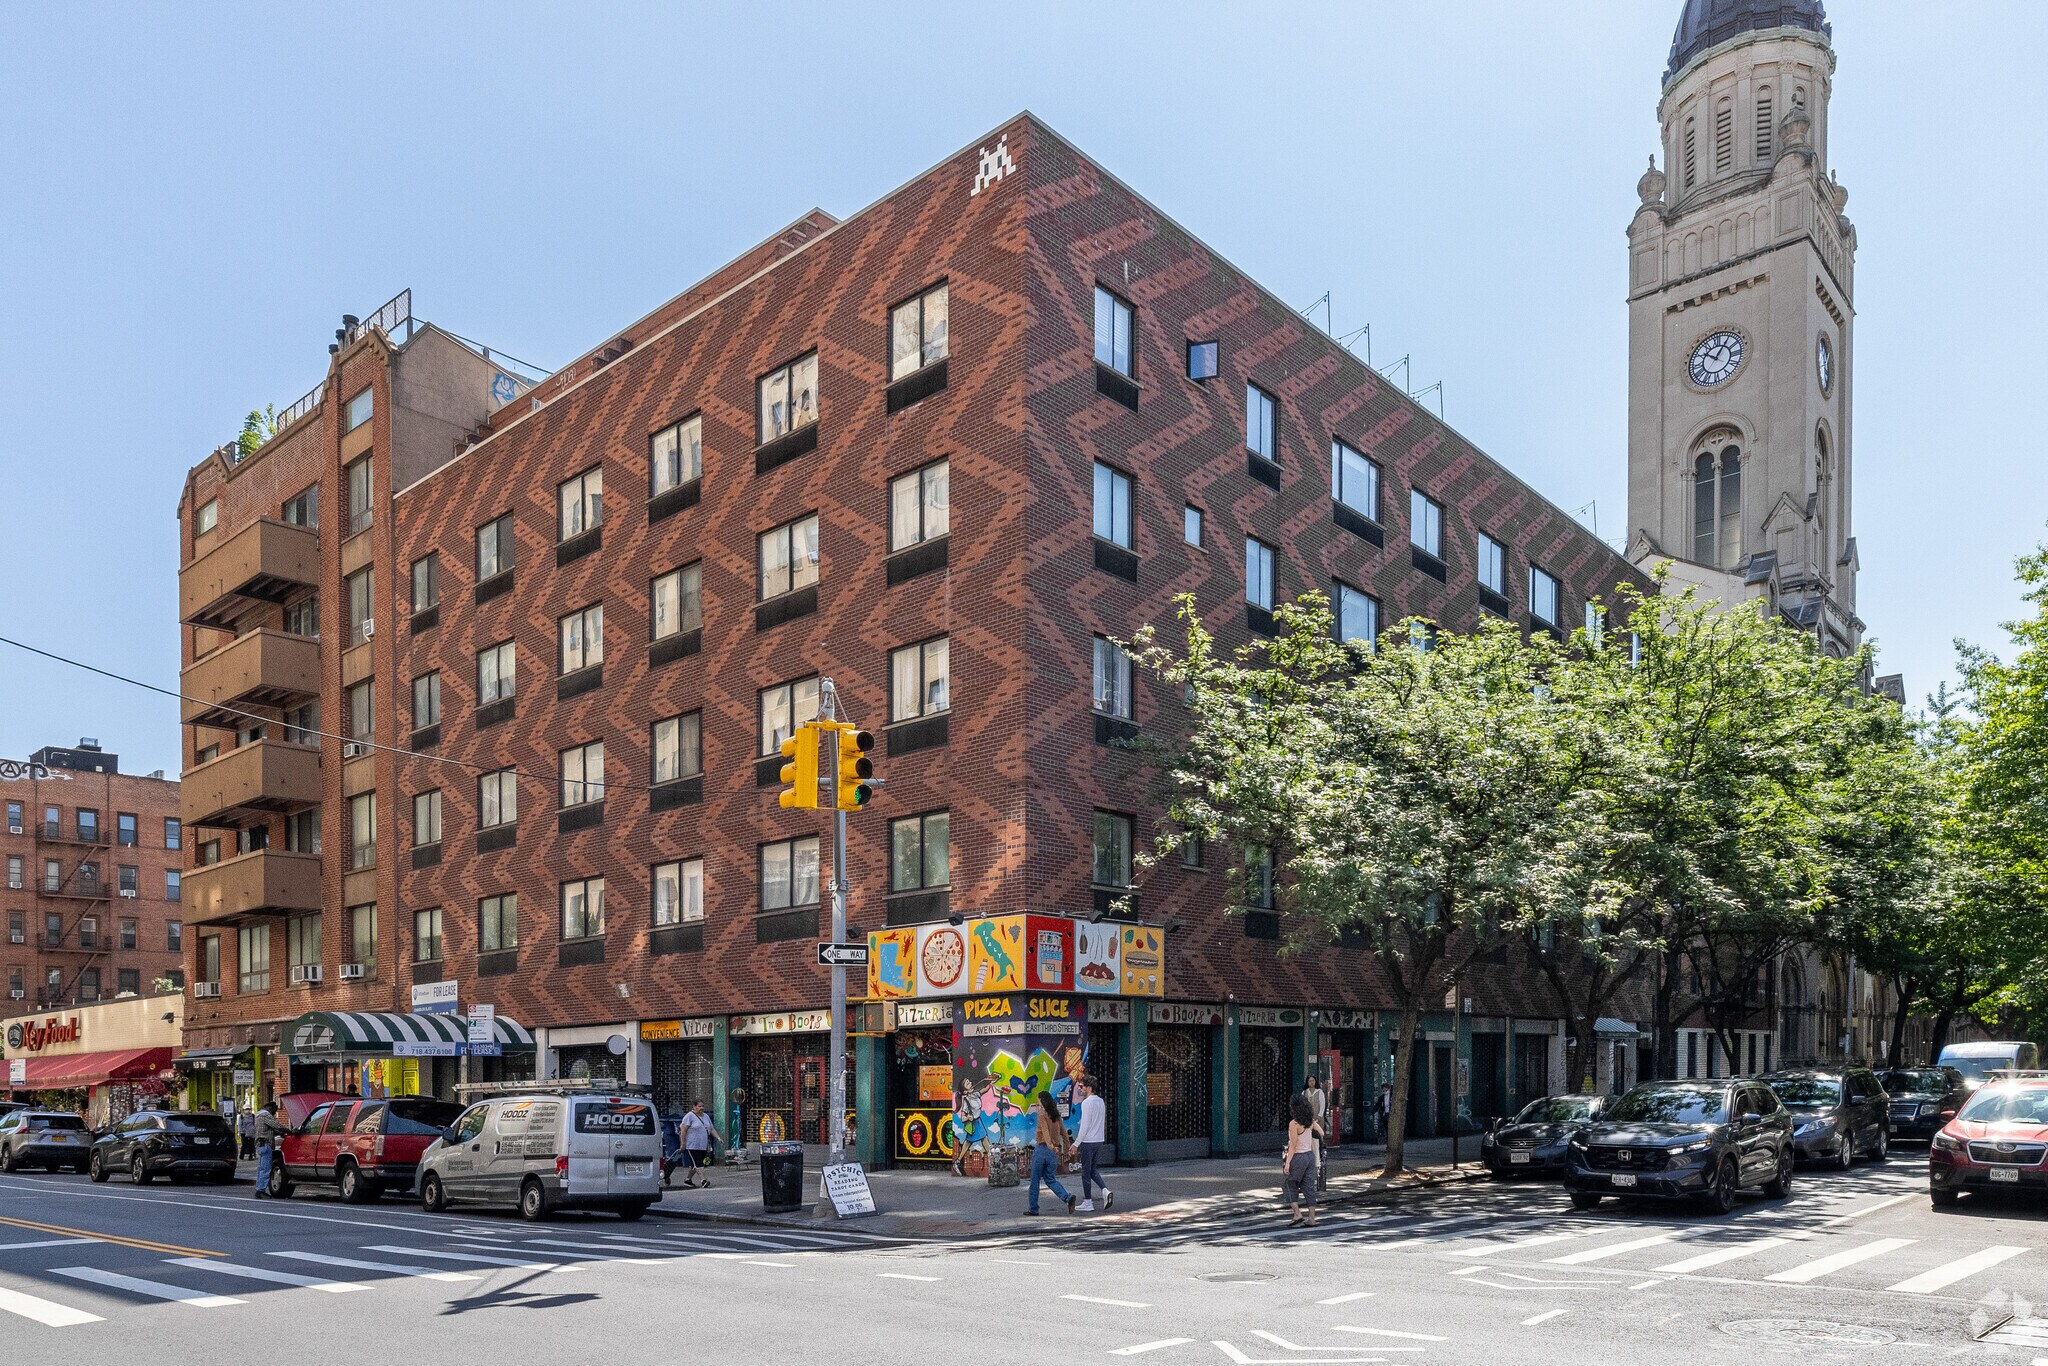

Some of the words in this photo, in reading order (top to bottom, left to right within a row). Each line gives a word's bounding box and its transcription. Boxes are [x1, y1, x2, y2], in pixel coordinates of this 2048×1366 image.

[982, 930, 1002, 958] ITALY
[826, 950, 841, 958] ONE
[850, 950, 864, 958] WAY
[434, 986, 442, 997] FOR
[443, 985, 456, 996] LEASE
[964, 998, 1012, 1020] PIZZA
[1029, 998, 1069, 1018] SLICE
[23, 1021, 46, 1051] Key
[45, 1017, 78, 1046] Food
[642, 1028, 680, 1040] CONVENIENCE
[976, 1025, 1002, 1034] AVENUE
[1007, 1025, 1012, 1033] A
[501, 1110, 529, 1118] HOODZ
[584, 1114, 646, 1126] HOODZ
[826, 1166, 862, 1180] PSYCHIC
